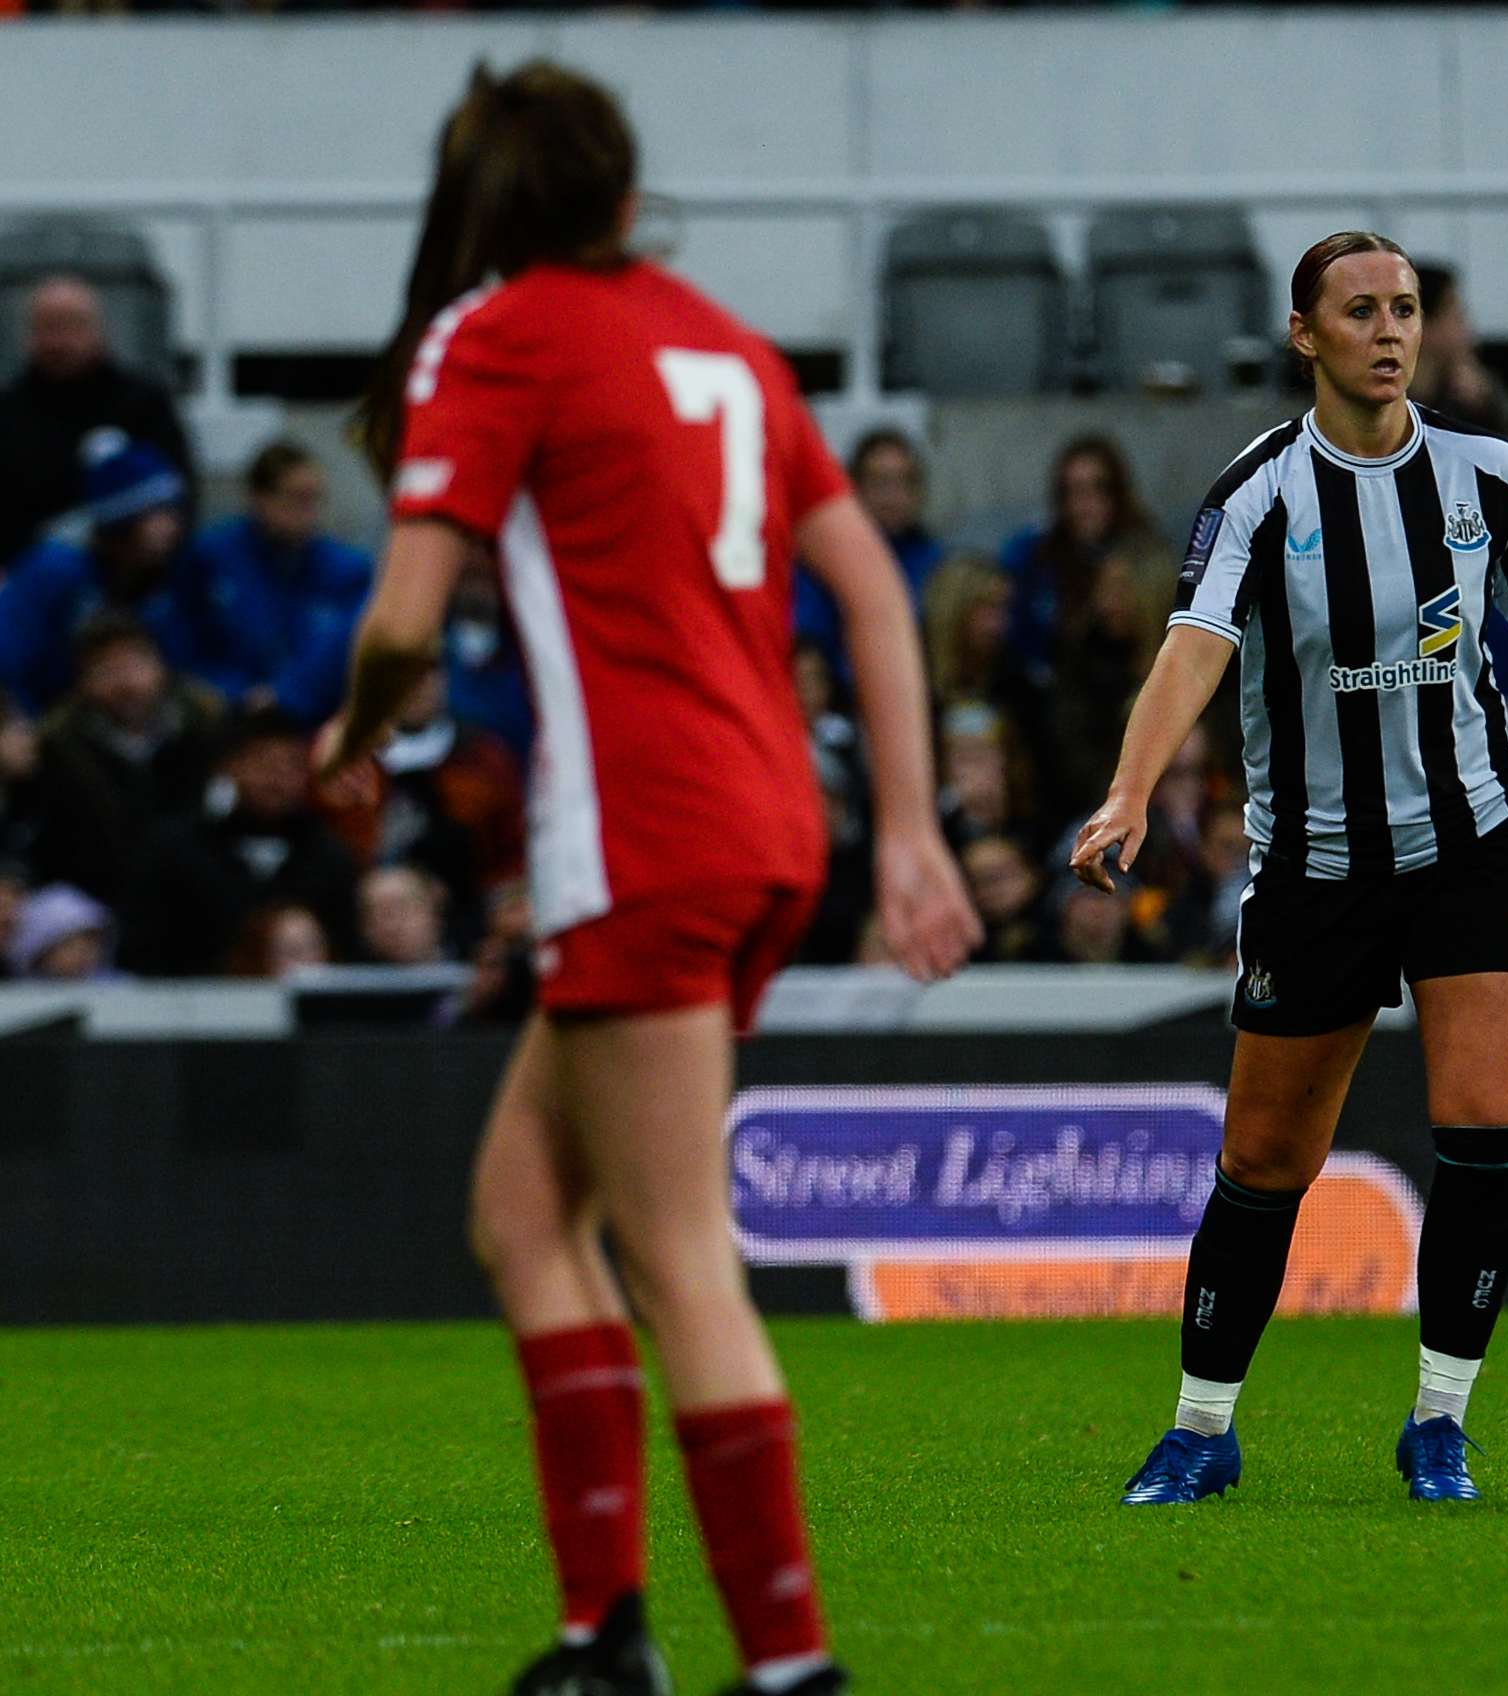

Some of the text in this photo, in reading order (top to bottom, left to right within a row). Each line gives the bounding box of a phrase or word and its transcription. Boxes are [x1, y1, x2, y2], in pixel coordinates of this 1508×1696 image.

[653, 346, 766, 591] 7
[1329, 659, 1457, 691] Straightline
[731, 1126, 921, 1207] Street
[1471, 1269, 1498, 1309] NUFC
